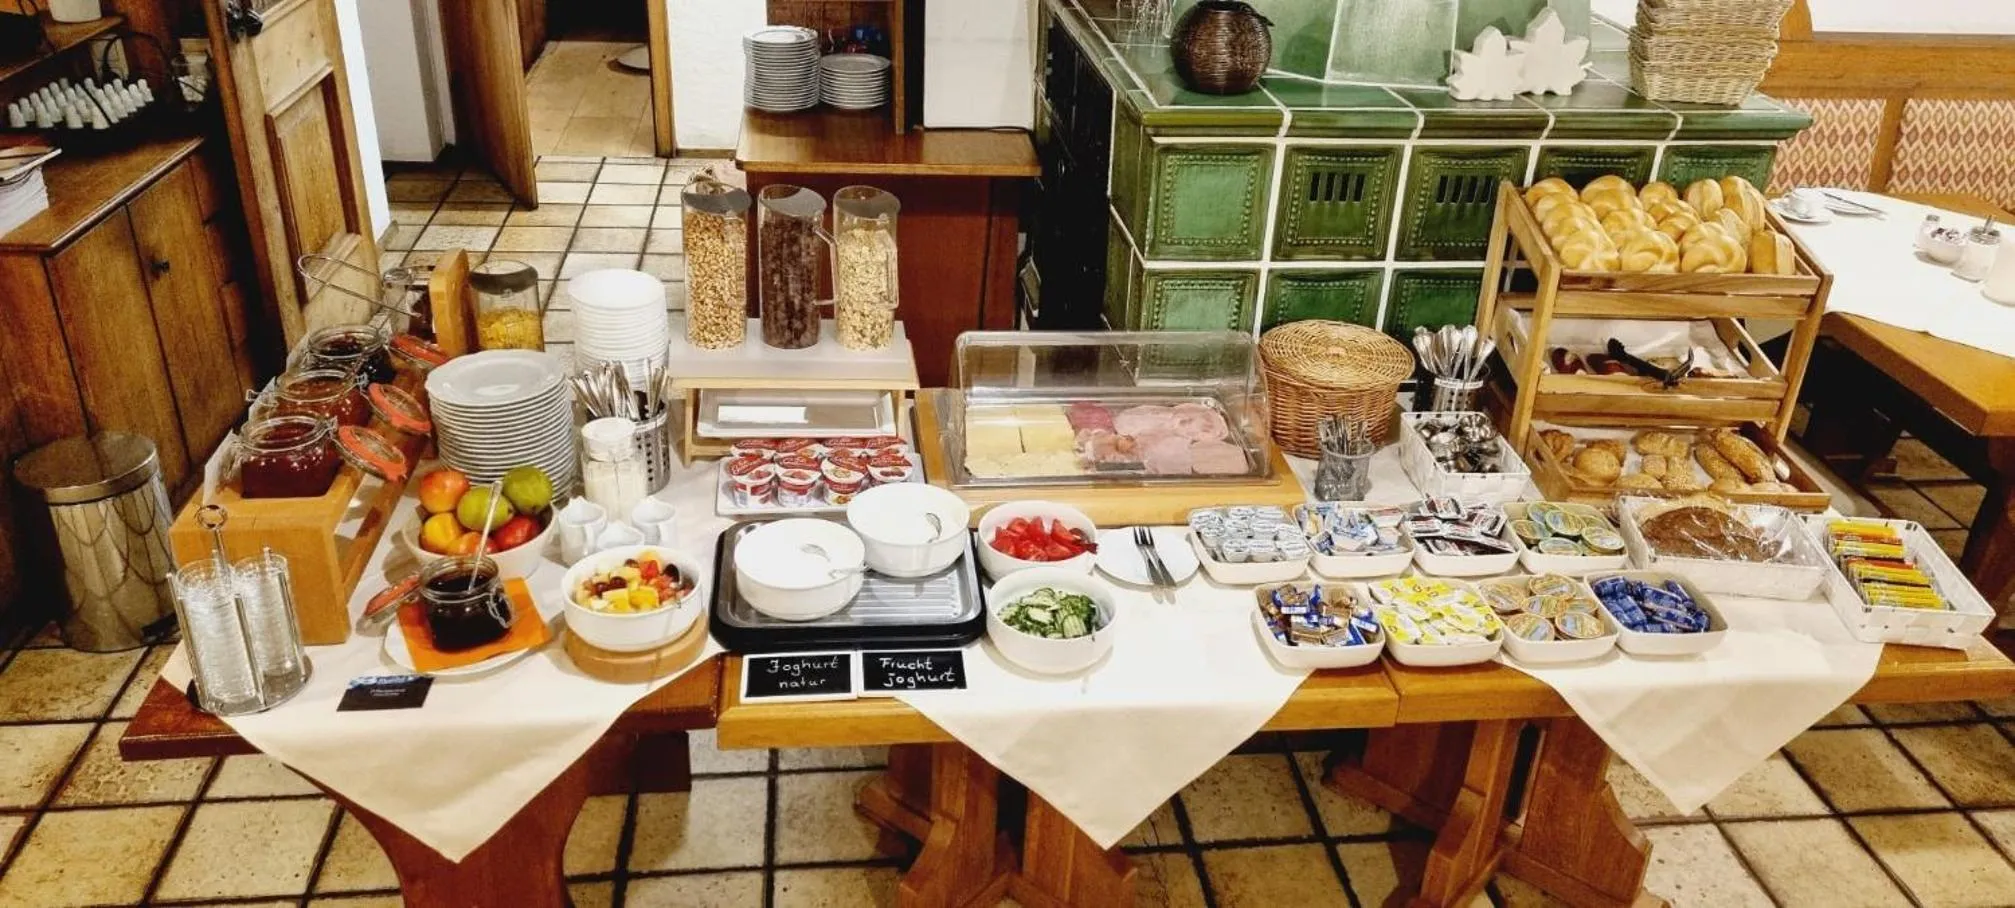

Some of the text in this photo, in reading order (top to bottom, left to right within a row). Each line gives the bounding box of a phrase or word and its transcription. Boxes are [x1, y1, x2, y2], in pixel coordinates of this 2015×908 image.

[767, 656, 838, 676] Joghurt
[879, 657, 933, 670] Frucht
[779, 677, 826, 688] natur
